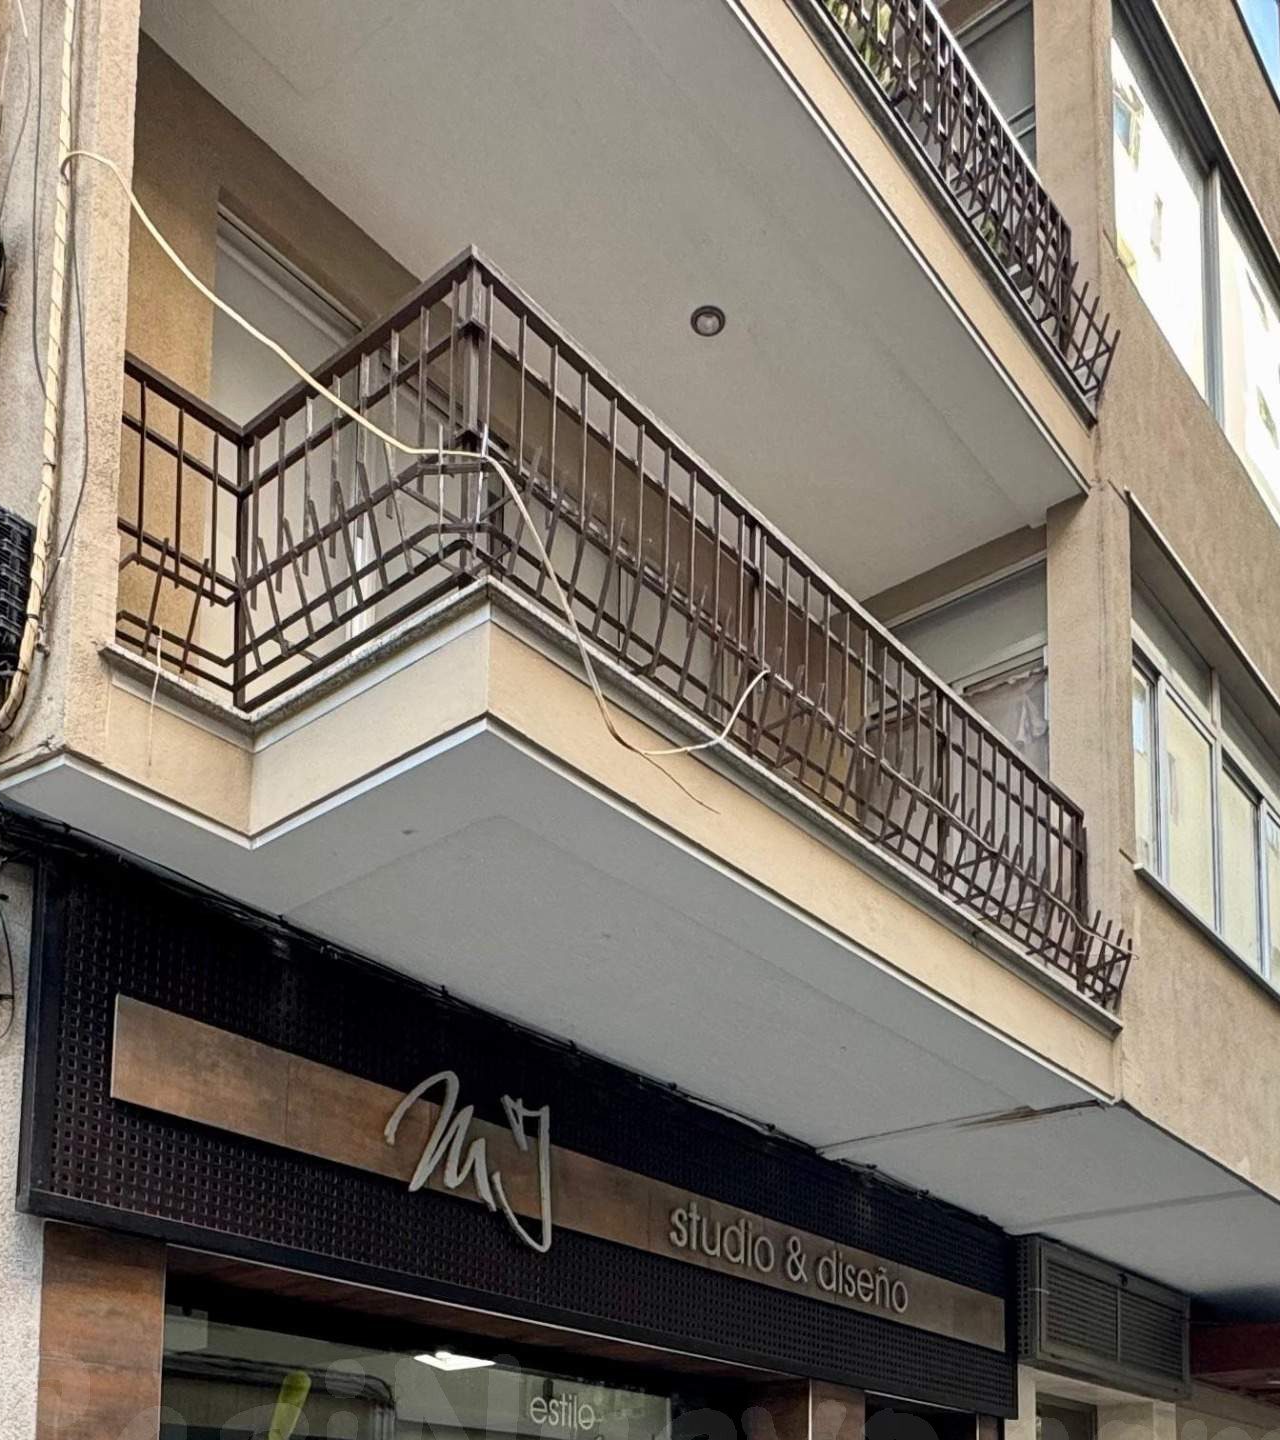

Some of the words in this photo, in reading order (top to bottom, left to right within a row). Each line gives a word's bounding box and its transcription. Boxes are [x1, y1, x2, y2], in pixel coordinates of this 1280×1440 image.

[669, 1201, 775, 1273] studio
[786, 1235, 808, 1283] &
[818, 1250, 909, 1314] diseño
[529, 1392, 595, 1431] estilo
